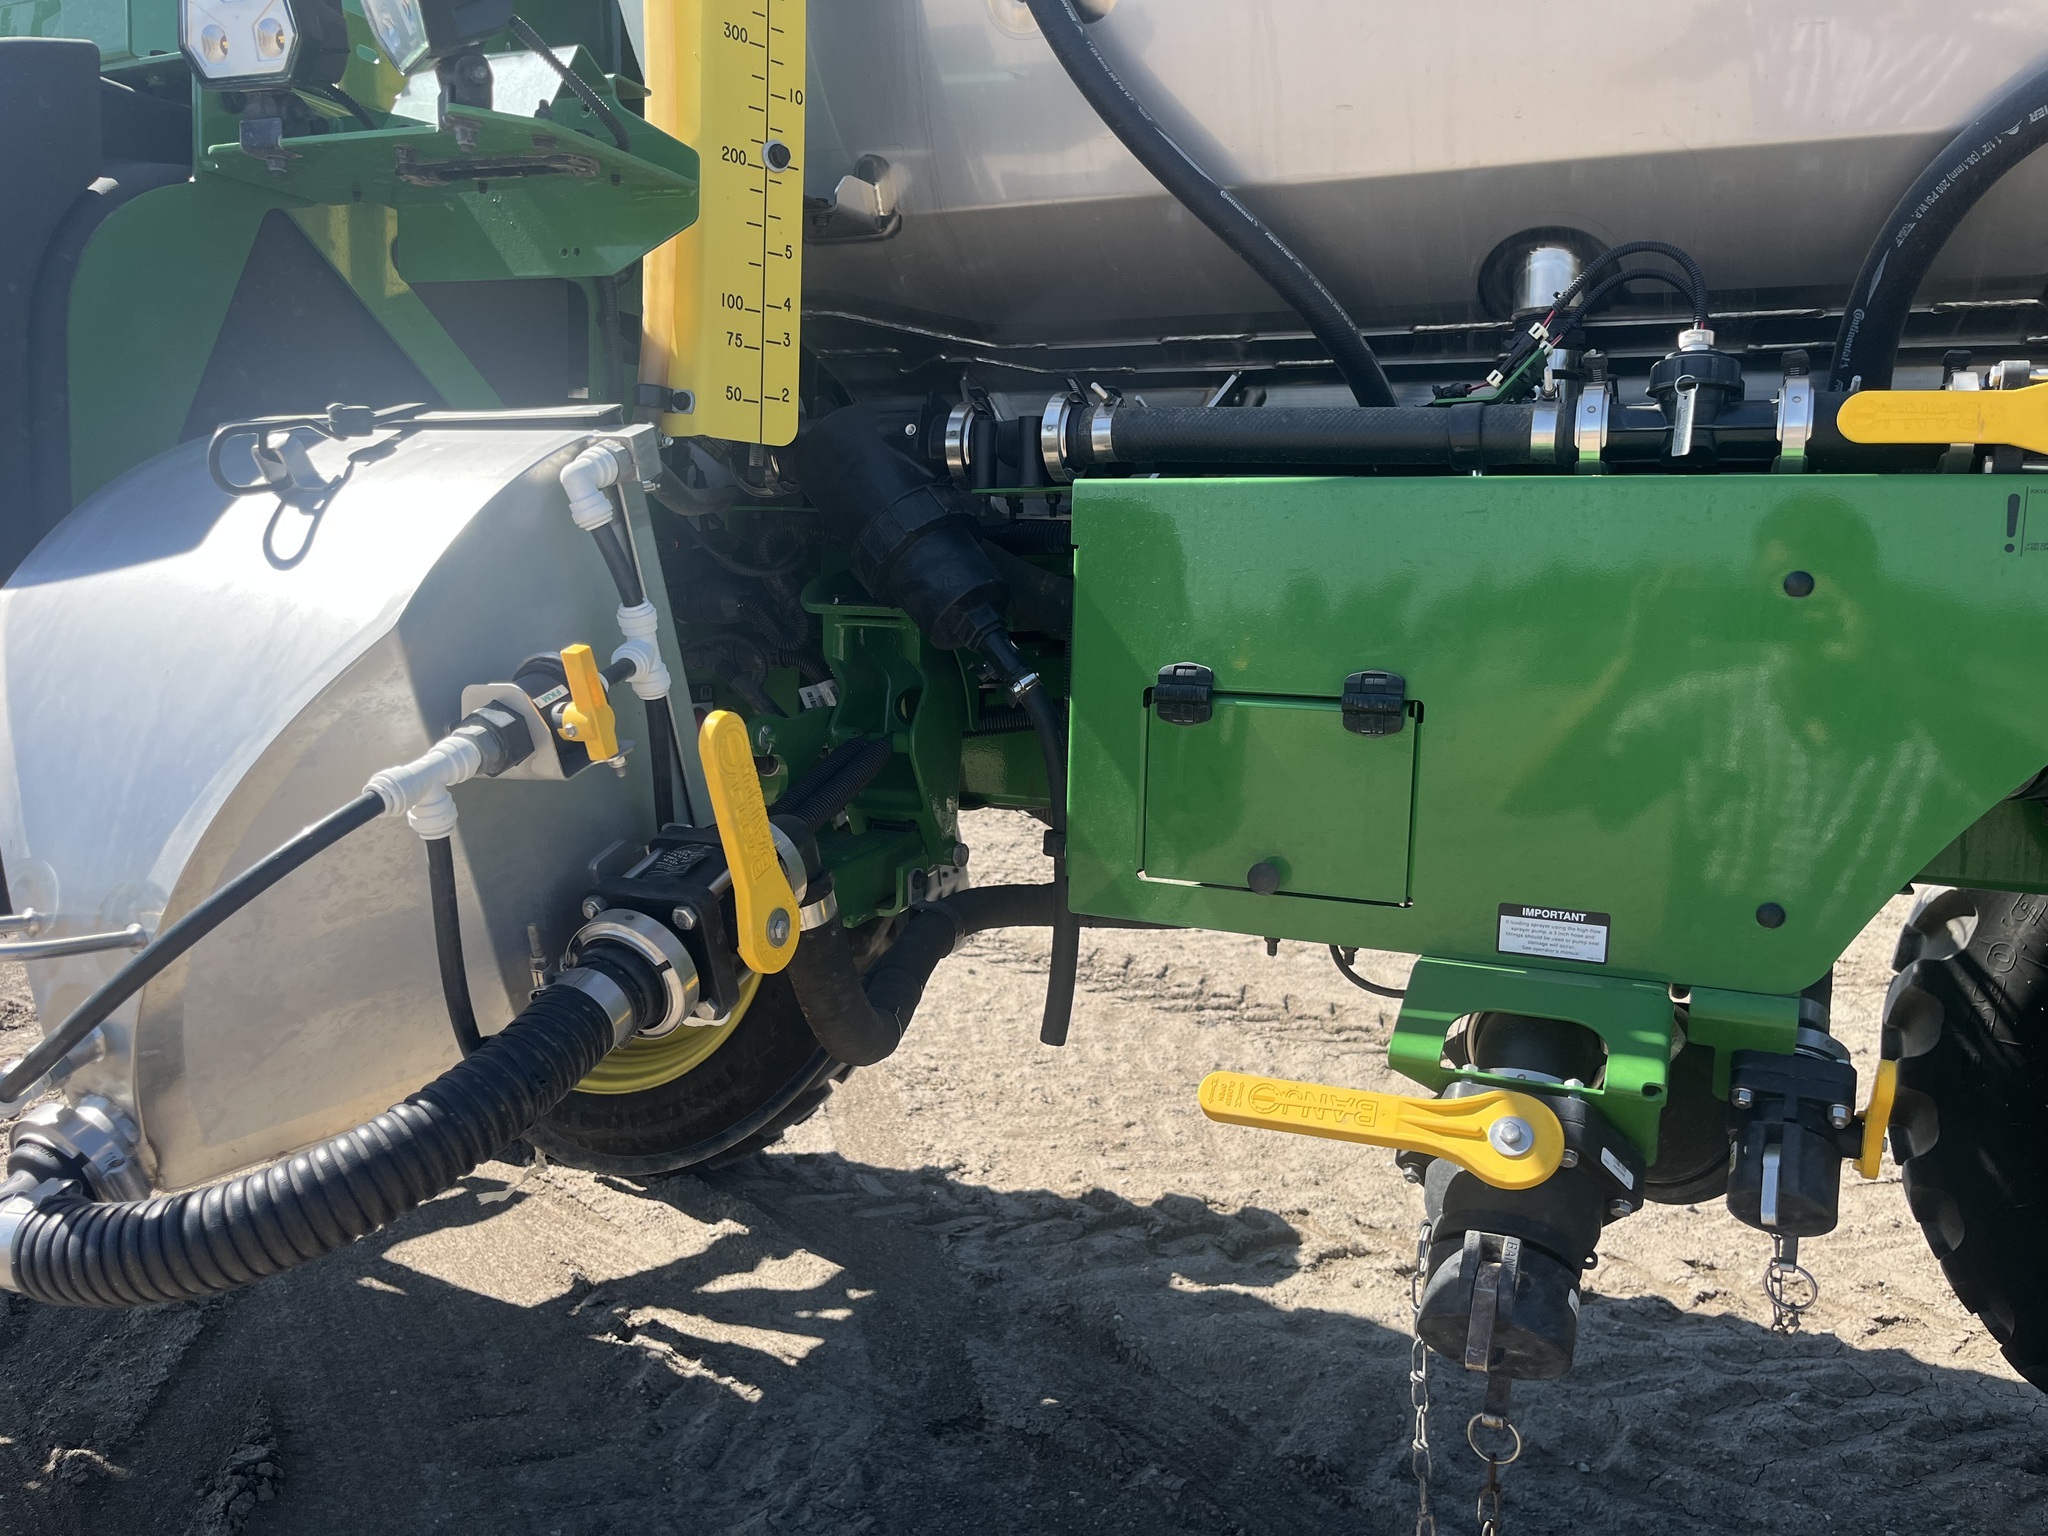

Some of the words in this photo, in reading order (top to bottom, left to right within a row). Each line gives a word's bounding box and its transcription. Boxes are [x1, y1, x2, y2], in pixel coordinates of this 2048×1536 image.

[724, 22, 748, 43] 300
[790, 88, 804, 105] 10
[722, 145, 746, 166] 200
[1946, 150, 1982, 183] (38.1mm)
[1936, 178, 1950, 194] 200
[1925, 190, 1940, 206] PSI
[1911, 203, 1930, 219] W.P.
[1220, 190, 1254, 223] Continental
[1264, 232, 1294, 260] FRONTIER
[784, 244, 793, 260] 5
[722, 292, 744, 311] 100
[784, 297, 792, 312] 4
[726, 331, 742, 348] 75
[782, 332, 790, 347] 3
[1840, 308, 1865, 362] Continental
[726, 385, 742, 402] 50
[781, 387, 790, 402] 2
[541, 689, 562, 703] FKM
[1522, 907, 1586, 922] IMPORTANT
[1225, 1080, 1235, 1106] CLOSED
[1248, 1082, 1379, 1128] BANJO
